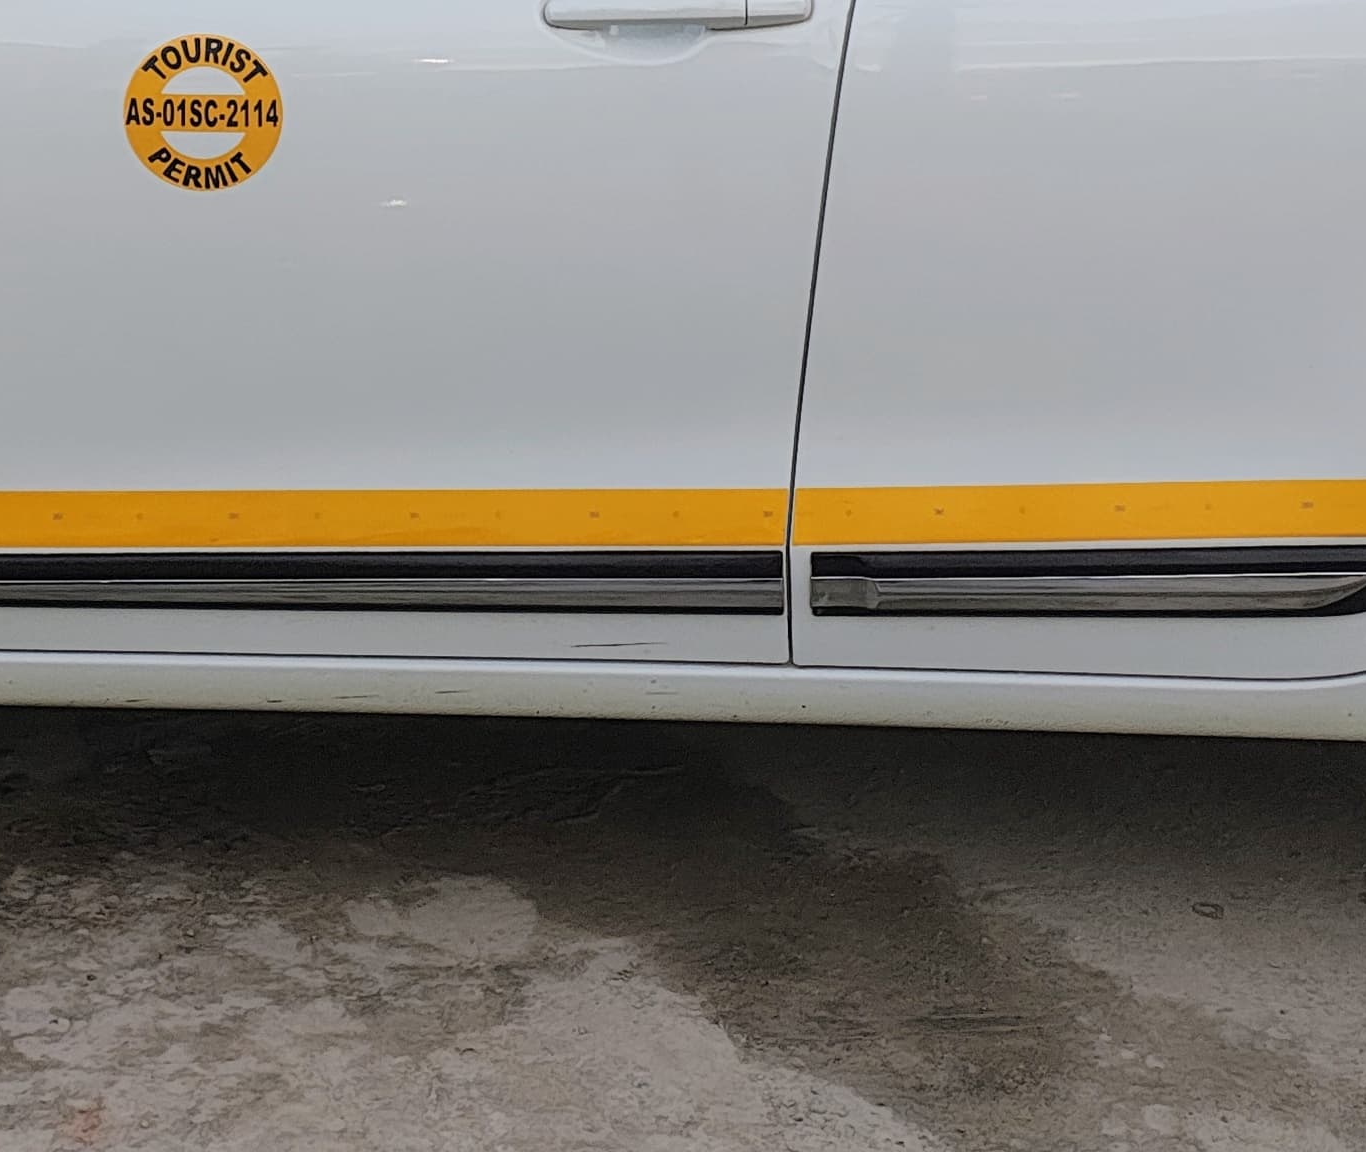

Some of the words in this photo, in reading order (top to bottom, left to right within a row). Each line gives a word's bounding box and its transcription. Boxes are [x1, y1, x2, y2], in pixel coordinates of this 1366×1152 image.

[142, 38, 268, 83] TOURIST
[126, 98, 279, 127] AS-01SC-2114
[148, 147, 252, 189] PERMIT
